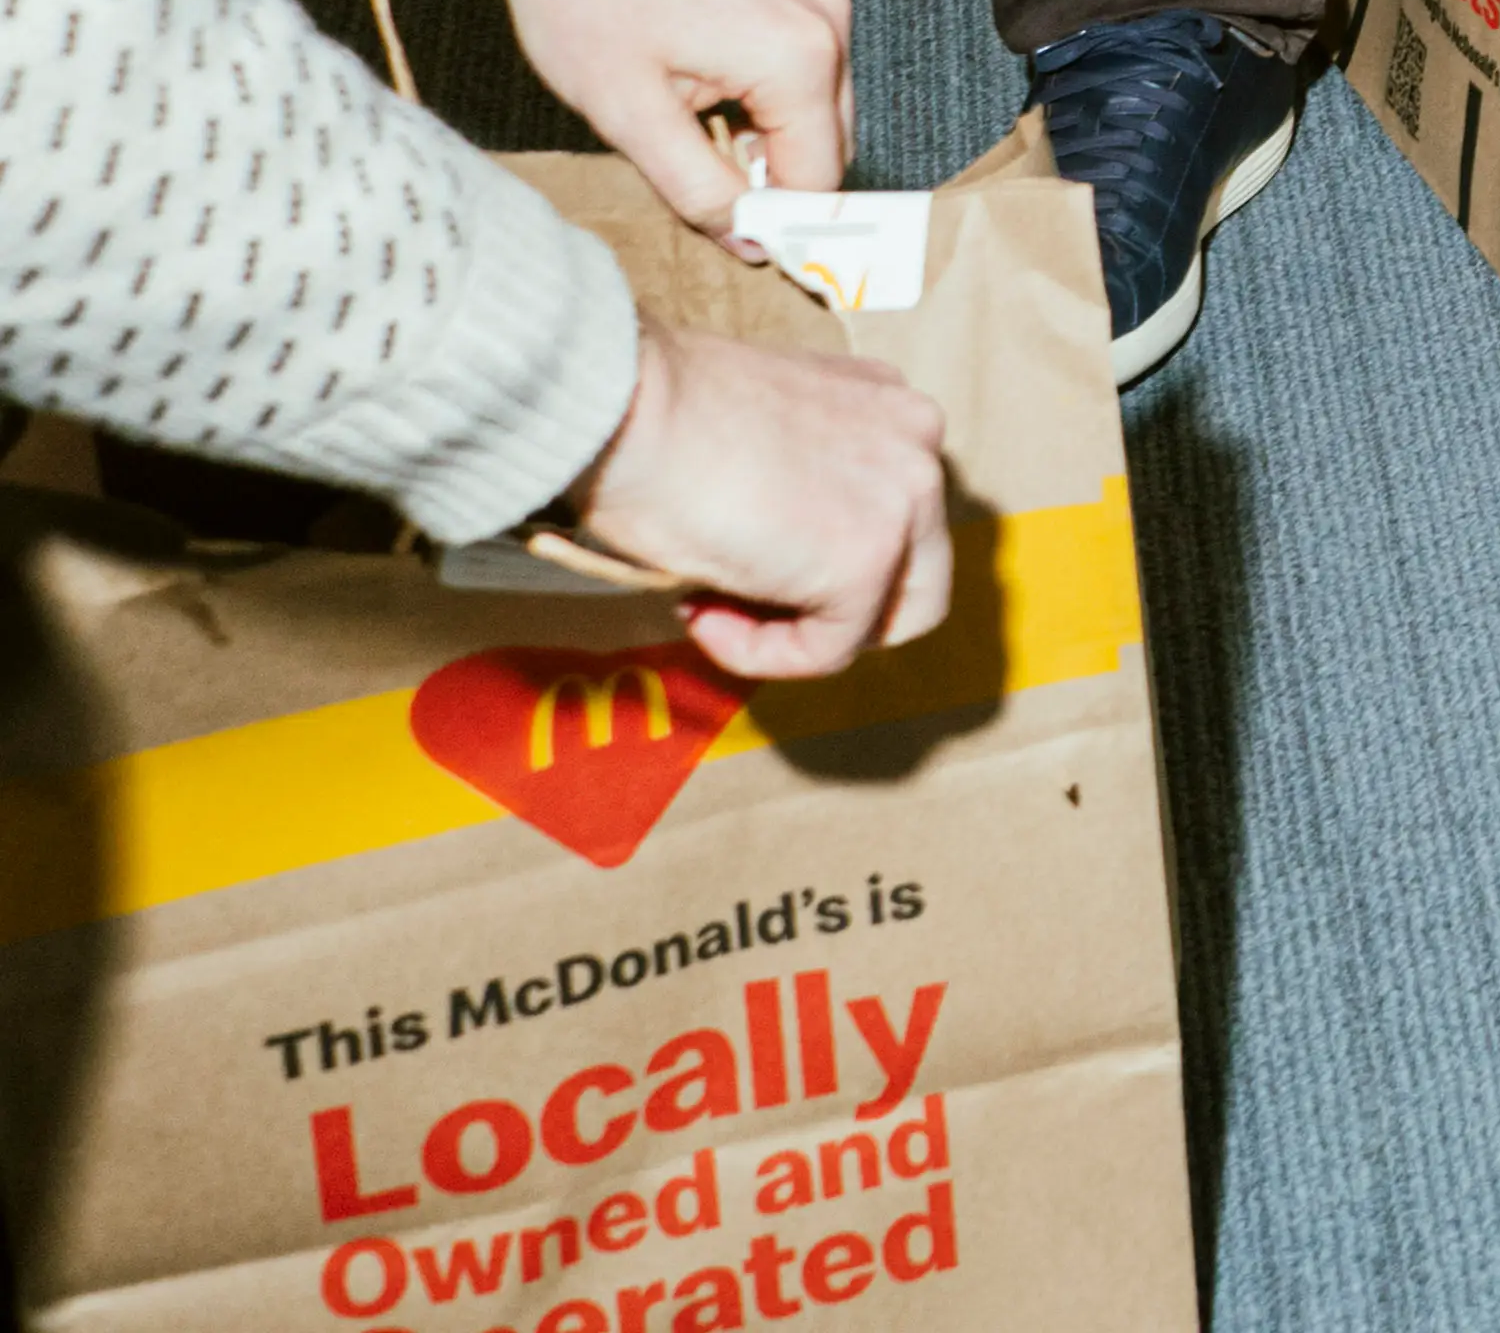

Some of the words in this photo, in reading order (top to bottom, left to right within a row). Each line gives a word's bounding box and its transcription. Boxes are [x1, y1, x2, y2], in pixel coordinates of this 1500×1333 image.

[265, 1006, 430, 1080] This
[449, 890, 851, 1039] McDonald's
[867, 873, 924, 925] is
[308, 968, 948, 1225] Locally
[319, 1146, 722, 1320] Owned
[754, 1092, 951, 1216] and
[361, 1180, 959, 1333] rated
